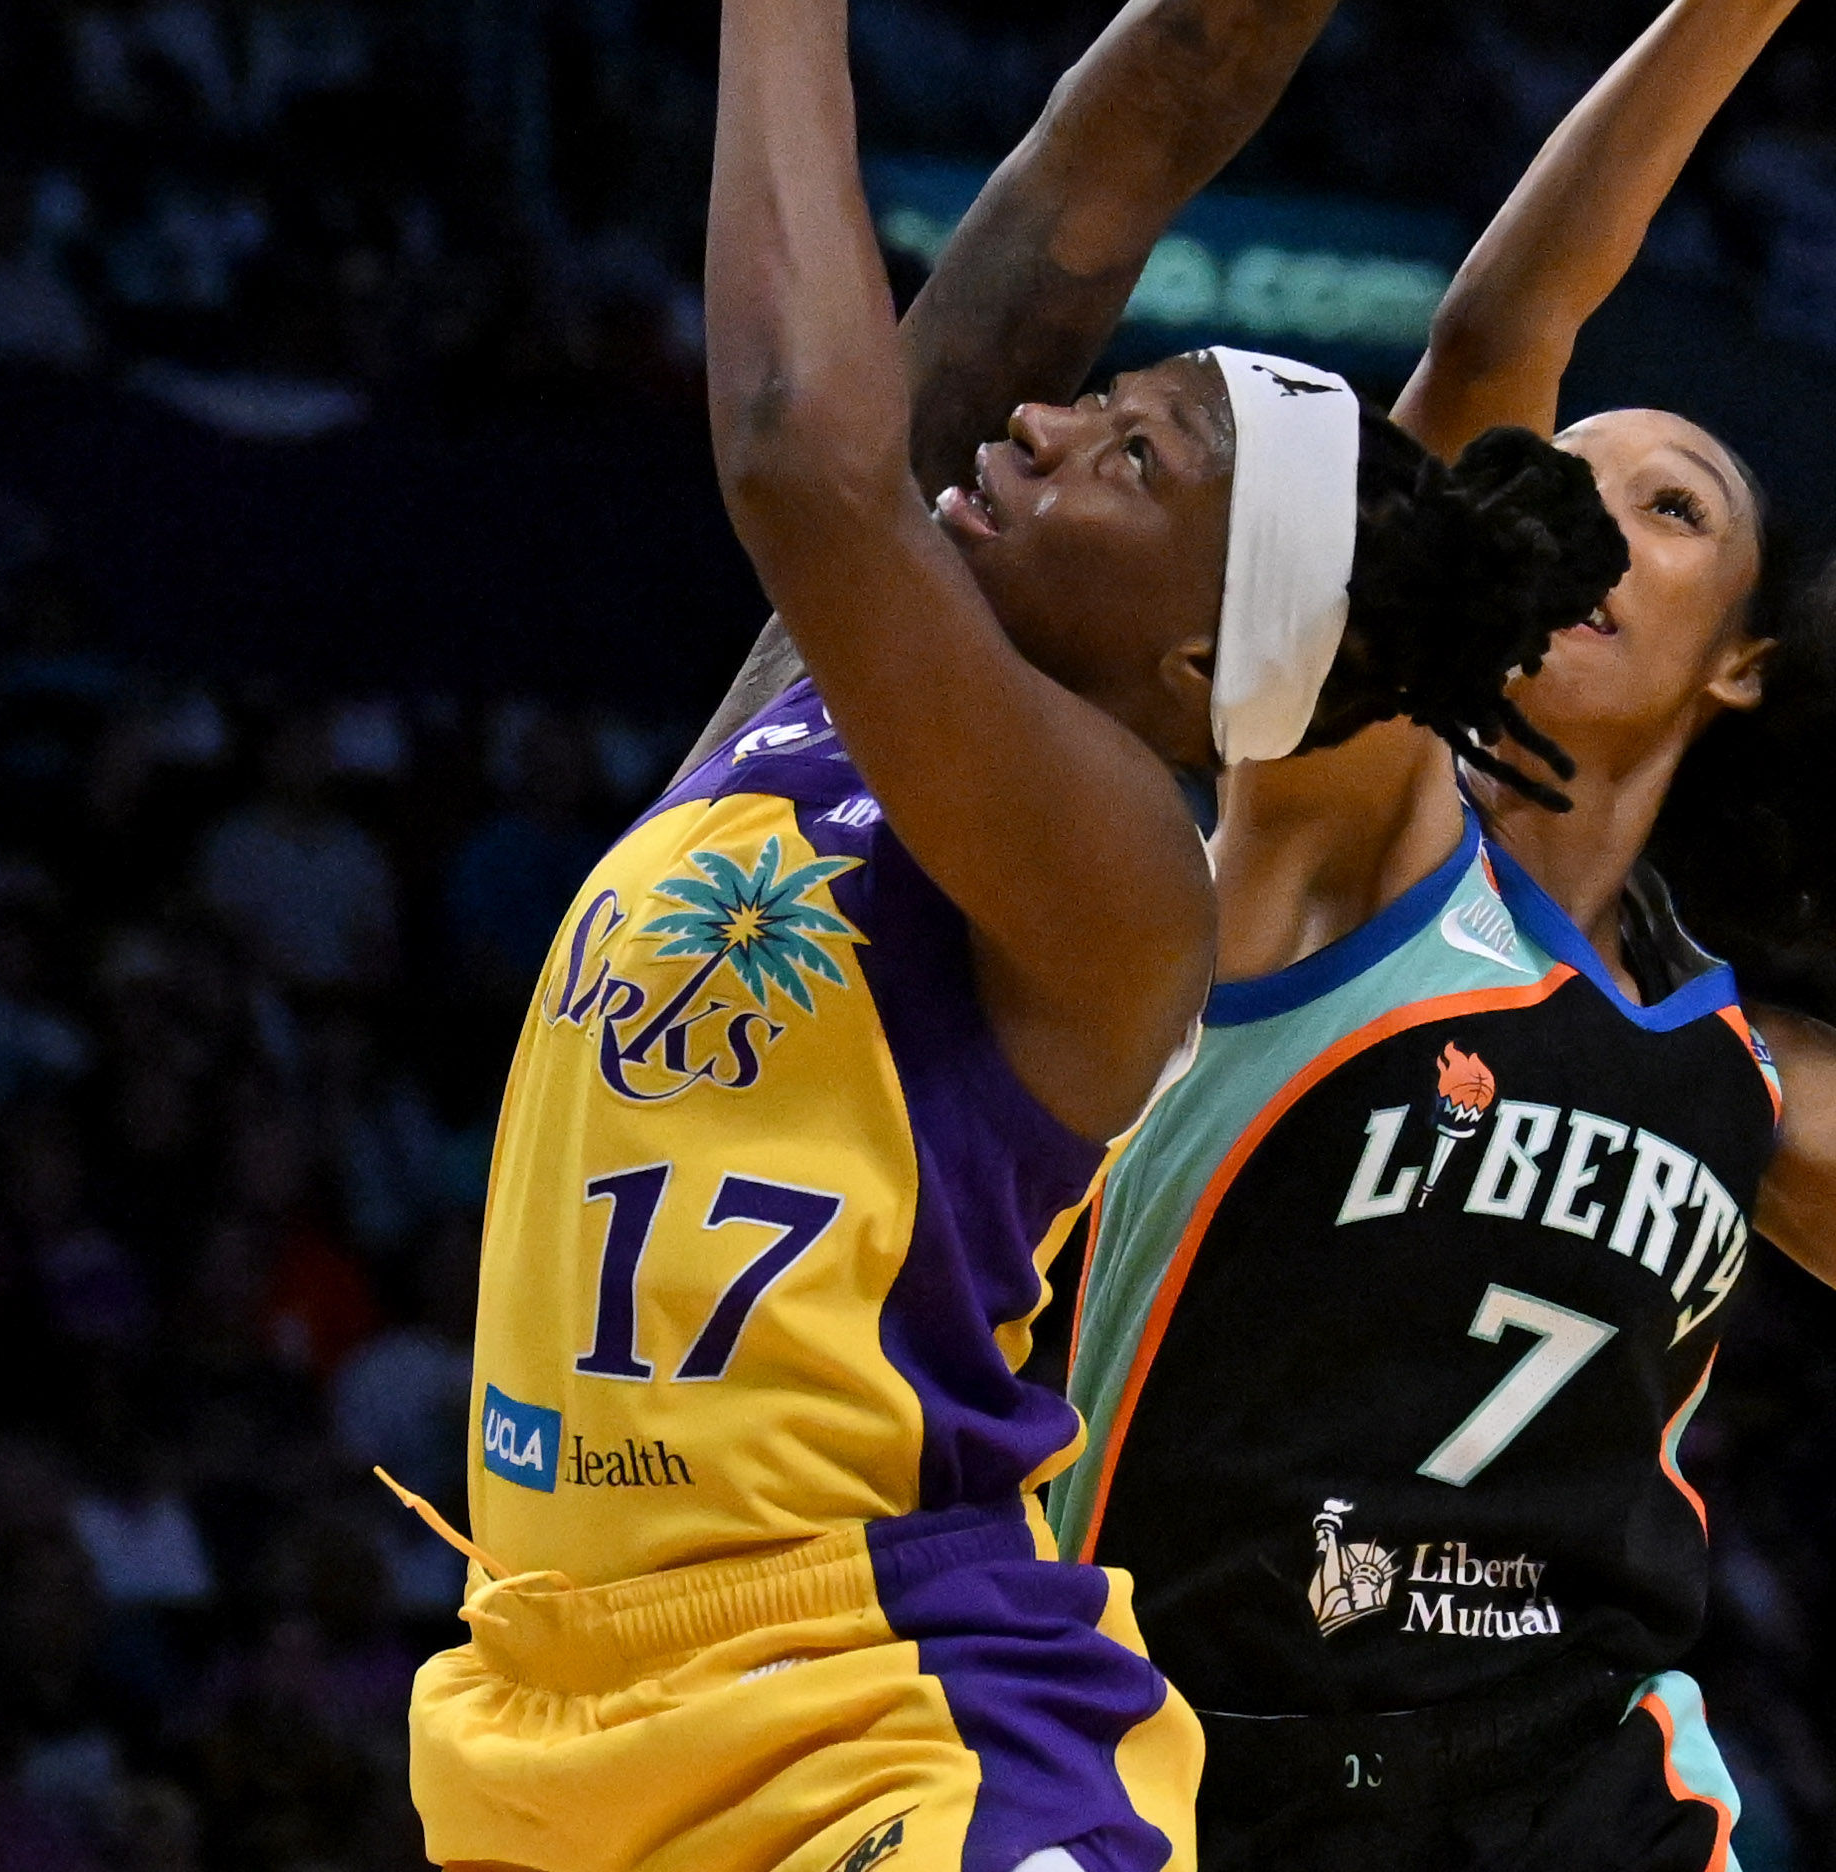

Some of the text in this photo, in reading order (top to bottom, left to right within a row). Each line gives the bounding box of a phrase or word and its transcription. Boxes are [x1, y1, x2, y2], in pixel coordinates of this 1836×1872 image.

[574, 1161, 846, 1383] 17
[1415, 1282, 1620, 1488] 7
[484, 1408, 543, 1472] UCLA
[1407, 1540, 1548, 1599] Liberty
[1400, 1591, 1562, 1640] Mutual
